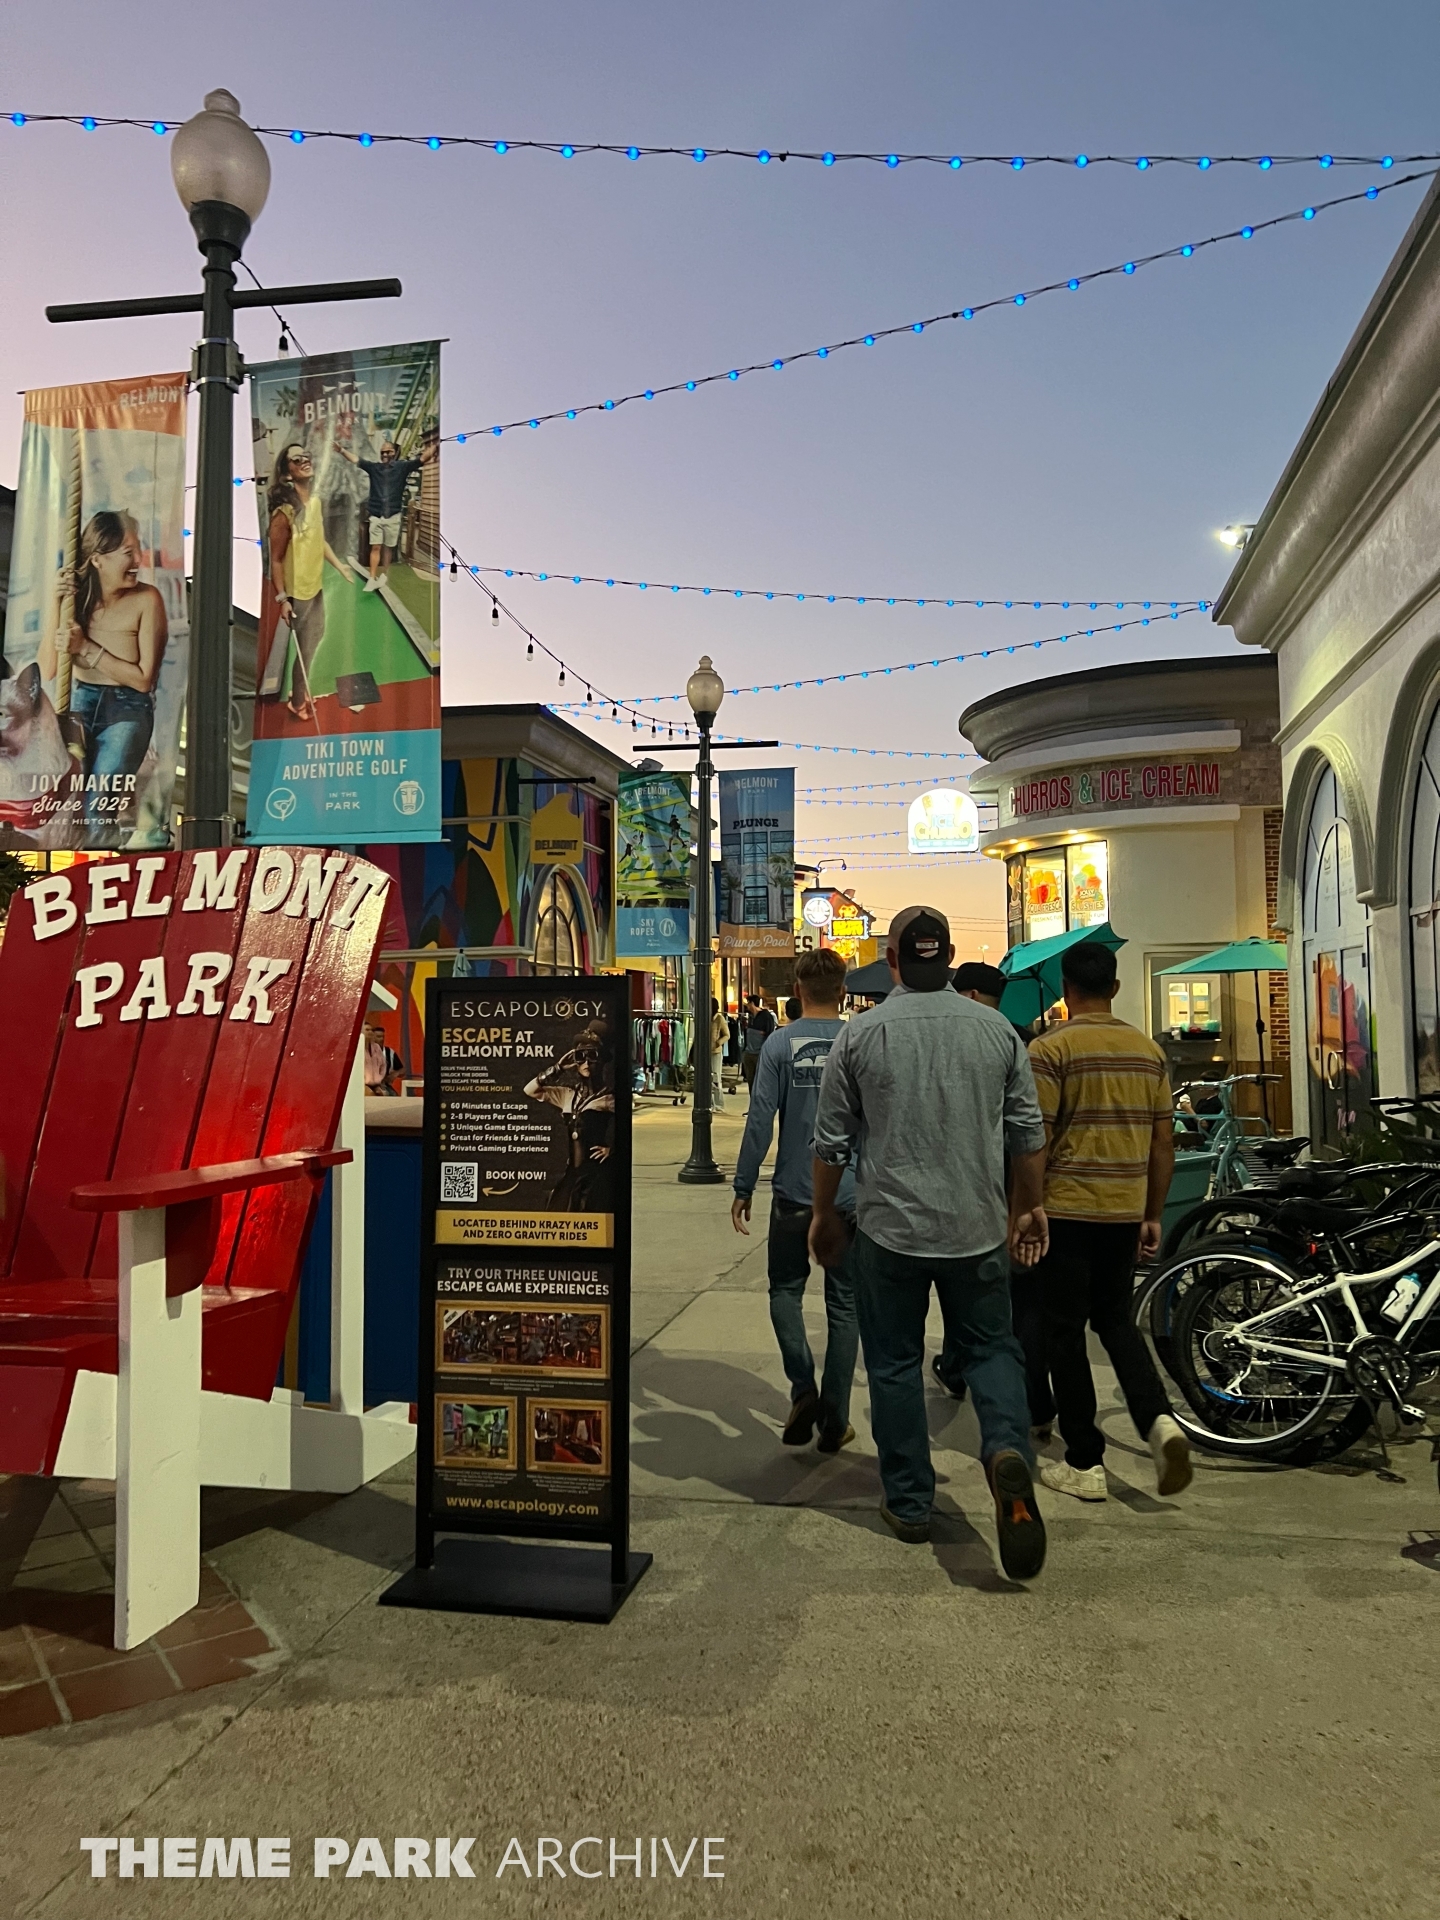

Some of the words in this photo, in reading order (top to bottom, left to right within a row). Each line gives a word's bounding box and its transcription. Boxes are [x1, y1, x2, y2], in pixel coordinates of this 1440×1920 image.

[304, 392, 386, 423] BELMONT
[306, 742, 334, 759] TIKI
[341, 739, 384, 757] TOWN
[283, 761, 364, 780] ADVENTURE
[371, 759, 408, 776] GOLF
[30, 774, 62, 792] JOY
[70, 774, 137, 792] MAKER
[1008, 775, 1073, 817] CHURROS
[1079, 772, 1094, 804] &
[1101, 768, 1132, 802] ICE
[1141, 763, 1220, 799] CREAM
[31, 795, 82, 815] Since
[89, 797, 131, 811] 1925
[325, 801, 361, 811] PARK
[733, 818, 779, 830] PLUNGE
[535, 839, 578, 851] BELMONT
[24, 849, 391, 941] BELMONT
[640, 918, 655, 927] SKY
[630, 927, 655, 936] ROPES
[724, 935, 762, 950] Plunge
[763, 934, 790, 947] Pool
[75, 951, 292, 1028] PARK
[451, 1000, 603, 1018] ESCAPOLOGY
[442, 1028, 512, 1043] ESCAPE
[515, 1030, 534, 1043] AT
[441, 1045, 512, 1058] BELMONT
[516, 1045, 554, 1058] PARK
[450, 1102, 460, 1110] 60
[461, 1102, 491, 1110] Minutes
[492, 1102, 501, 1110] to
[502, 1102, 528, 1111] Escape
[450, 1112, 463, 1120] 2-8
[464, 1112, 491, 1122] Players
[492, 1112, 505, 1120] Per
[506, 1112, 528, 1121] Game
[450, 1123, 455, 1131] 3
[456, 1123, 483, 1132] Unique
[484, 1123, 506, 1131] Game
[507, 1123, 552, 1132] Experiences
[484, 1134, 513, 1142] Friends
[513, 1134, 519, 1142] &
[520, 1134, 551, 1142] Families
[450, 1144, 477, 1152] Private
[477, 1144, 507, 1153] Gaming
[507, 1144, 549, 1153] Experience
[485, 1170, 515, 1180] BOOK
[517, 1170, 547, 1180] NOW!
[453, 1218, 497, 1228] LOCATED
[499, 1219, 537, 1229] BEHIND
[539, 1220, 571, 1230] KRAZY
[573, 1221, 599, 1230] KARS
[463, 1229, 484, 1239] AND
[486, 1230, 512, 1239] ZERO
[514, 1231, 557, 1240] GRAVITY
[559, 1231, 588, 1241] RIDES
[447, 1267, 471, 1279] TRY
[474, 1268, 501, 1280] OUR
[505, 1268, 545, 1281] THREE
[548, 1270, 599, 1282] UNIQUE
[437, 1280, 483, 1292] ESCAPE
[486, 1281, 522, 1293] GAME
[525, 1283, 610, 1296] EXPERIENCES
[446, 1496, 599, 1516] www.escapology.com
